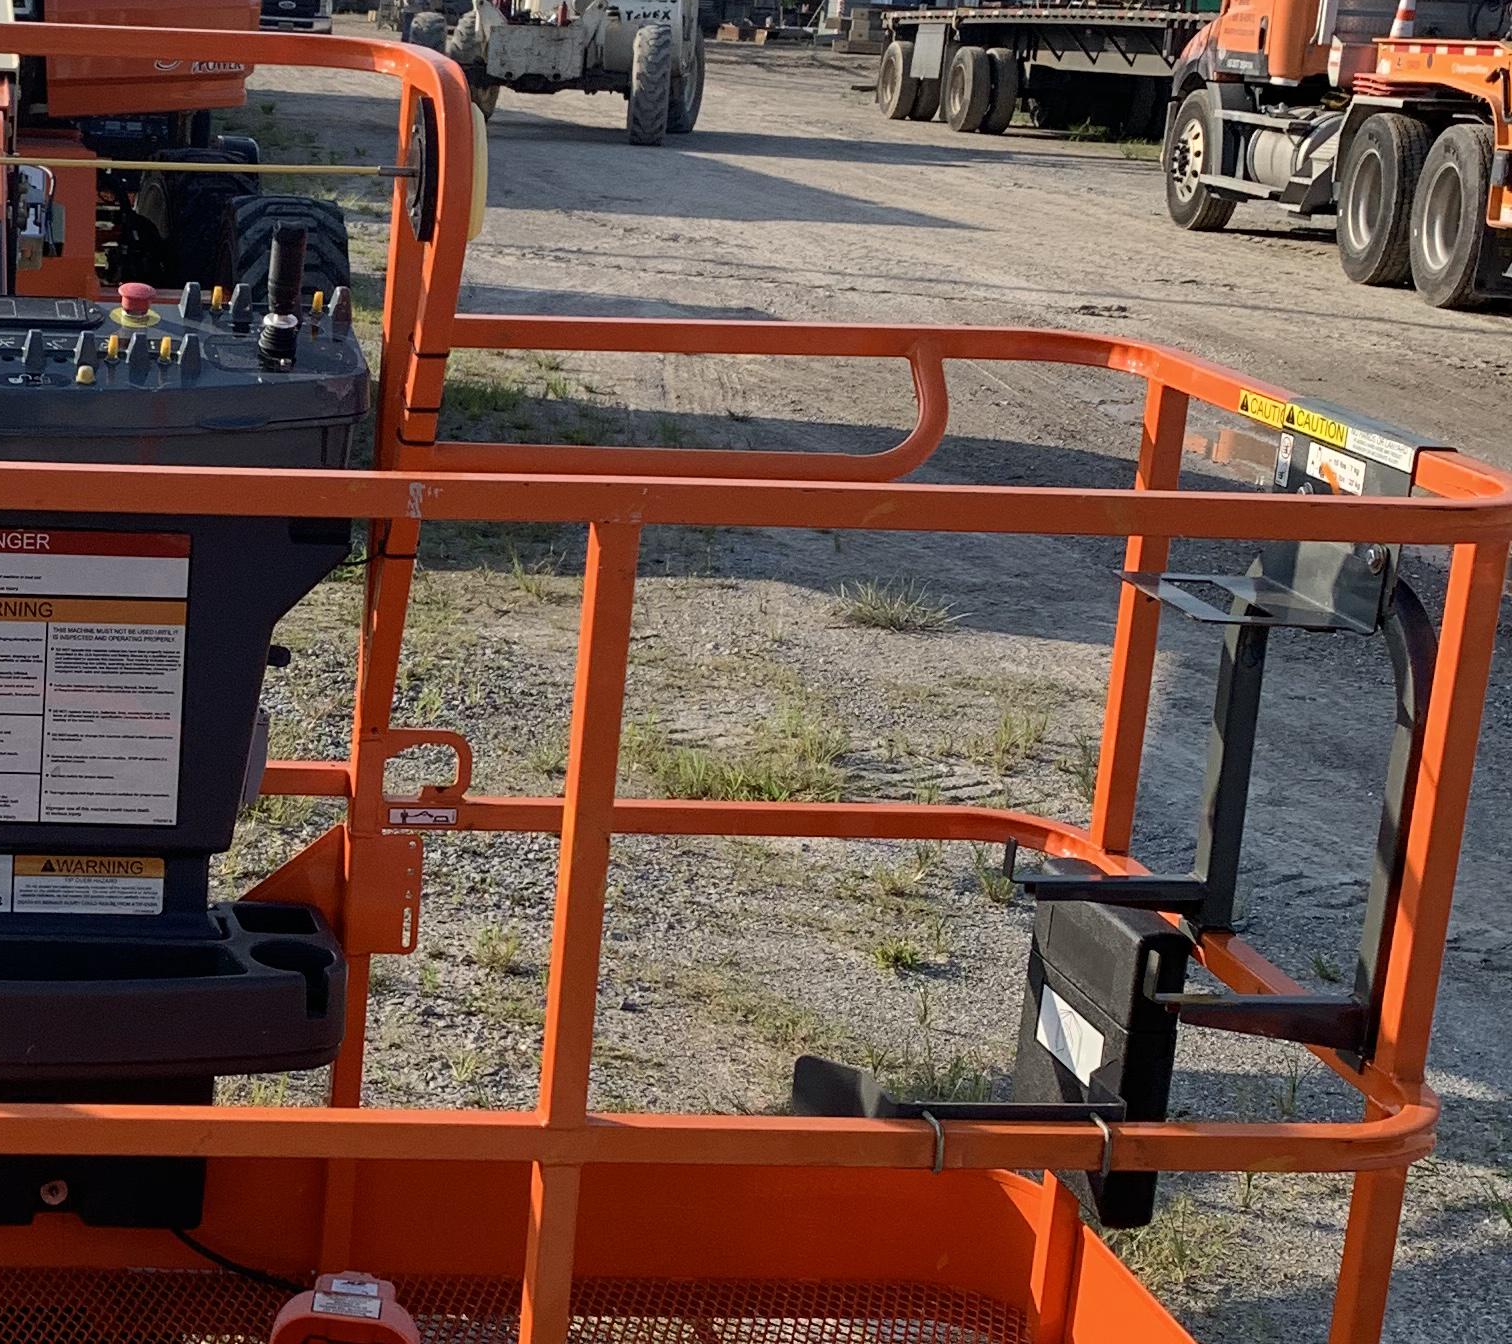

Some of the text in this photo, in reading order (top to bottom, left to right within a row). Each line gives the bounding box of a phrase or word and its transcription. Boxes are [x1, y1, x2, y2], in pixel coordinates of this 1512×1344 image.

[1251, 397, 1286, 424] CAUTI
[1297, 409, 1346, 443] CAUTION
[56, 859, 144, 874] WARNING
